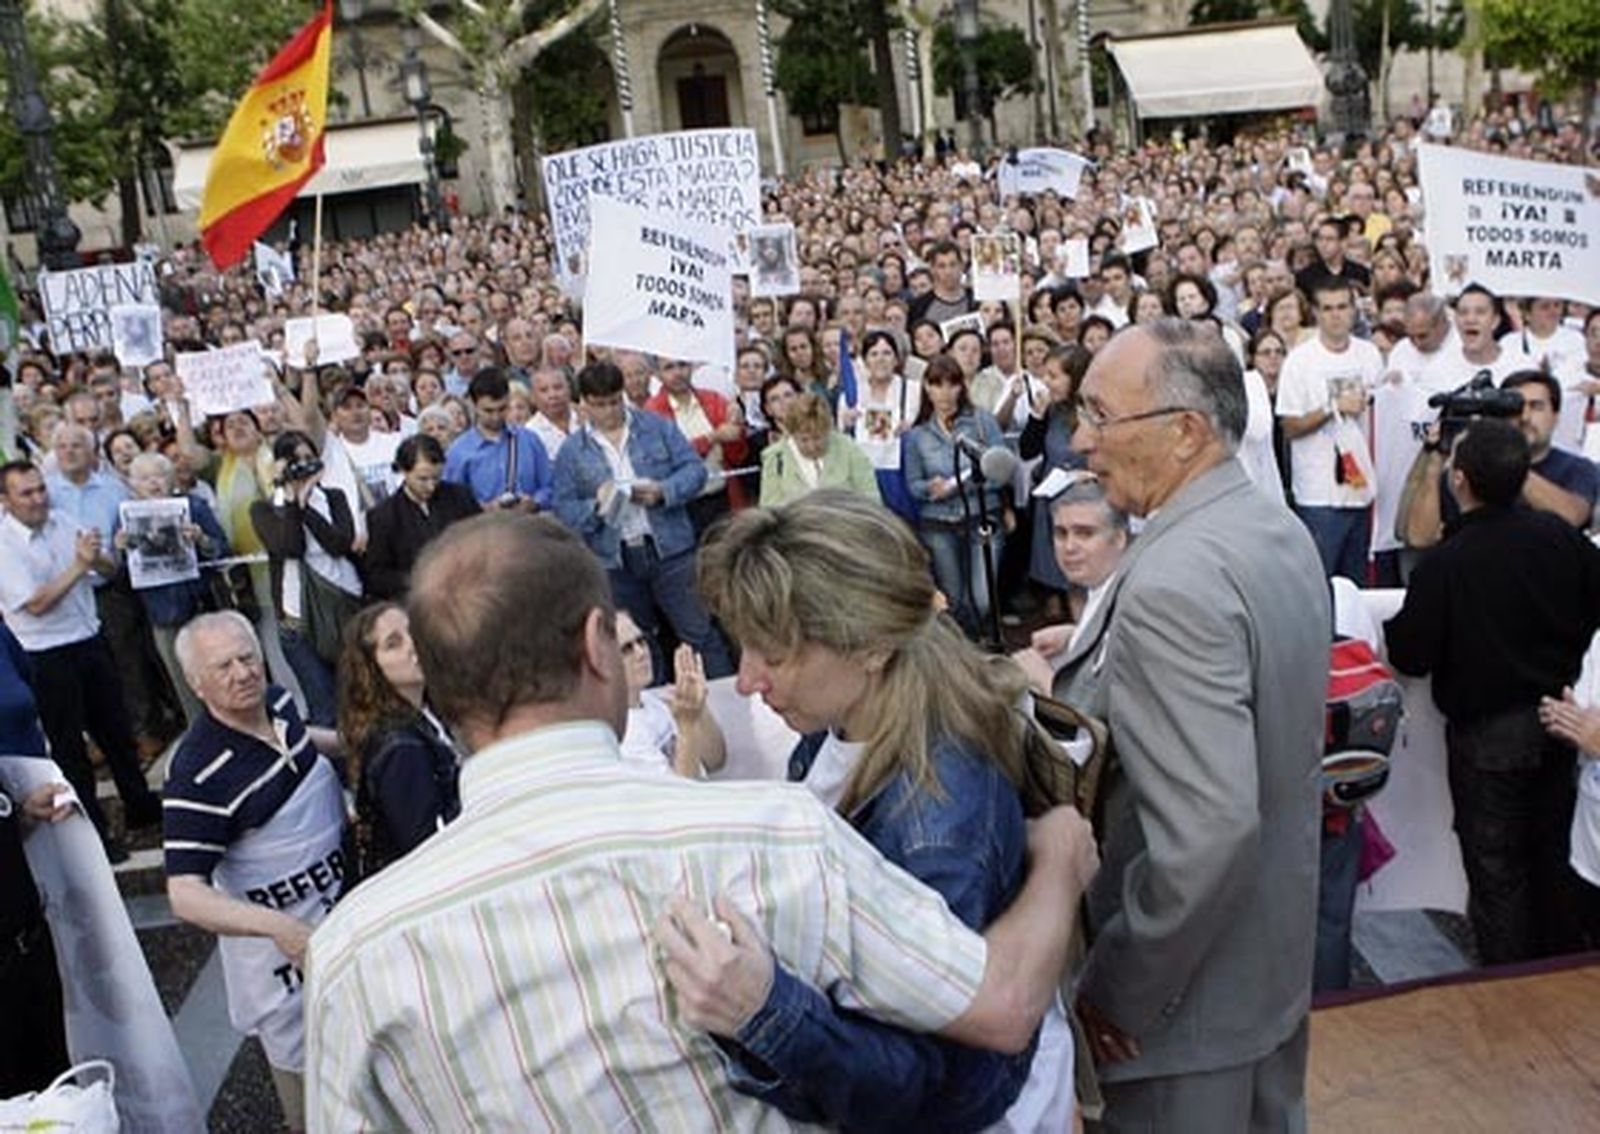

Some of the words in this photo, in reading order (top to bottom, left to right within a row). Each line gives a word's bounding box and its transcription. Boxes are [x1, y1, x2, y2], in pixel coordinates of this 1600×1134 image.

[664, 133, 755, 163] JUSTICIA
[1502, 201, 1547, 222] ¡YA!
[1466, 226, 1525, 244] TODOS
[1530, 228, 1588, 249] SOMOS
[1486, 249, 1562, 269] MARTA
[636, 273, 687, 299] TODOS
[648, 299, 705, 327] MARTA
